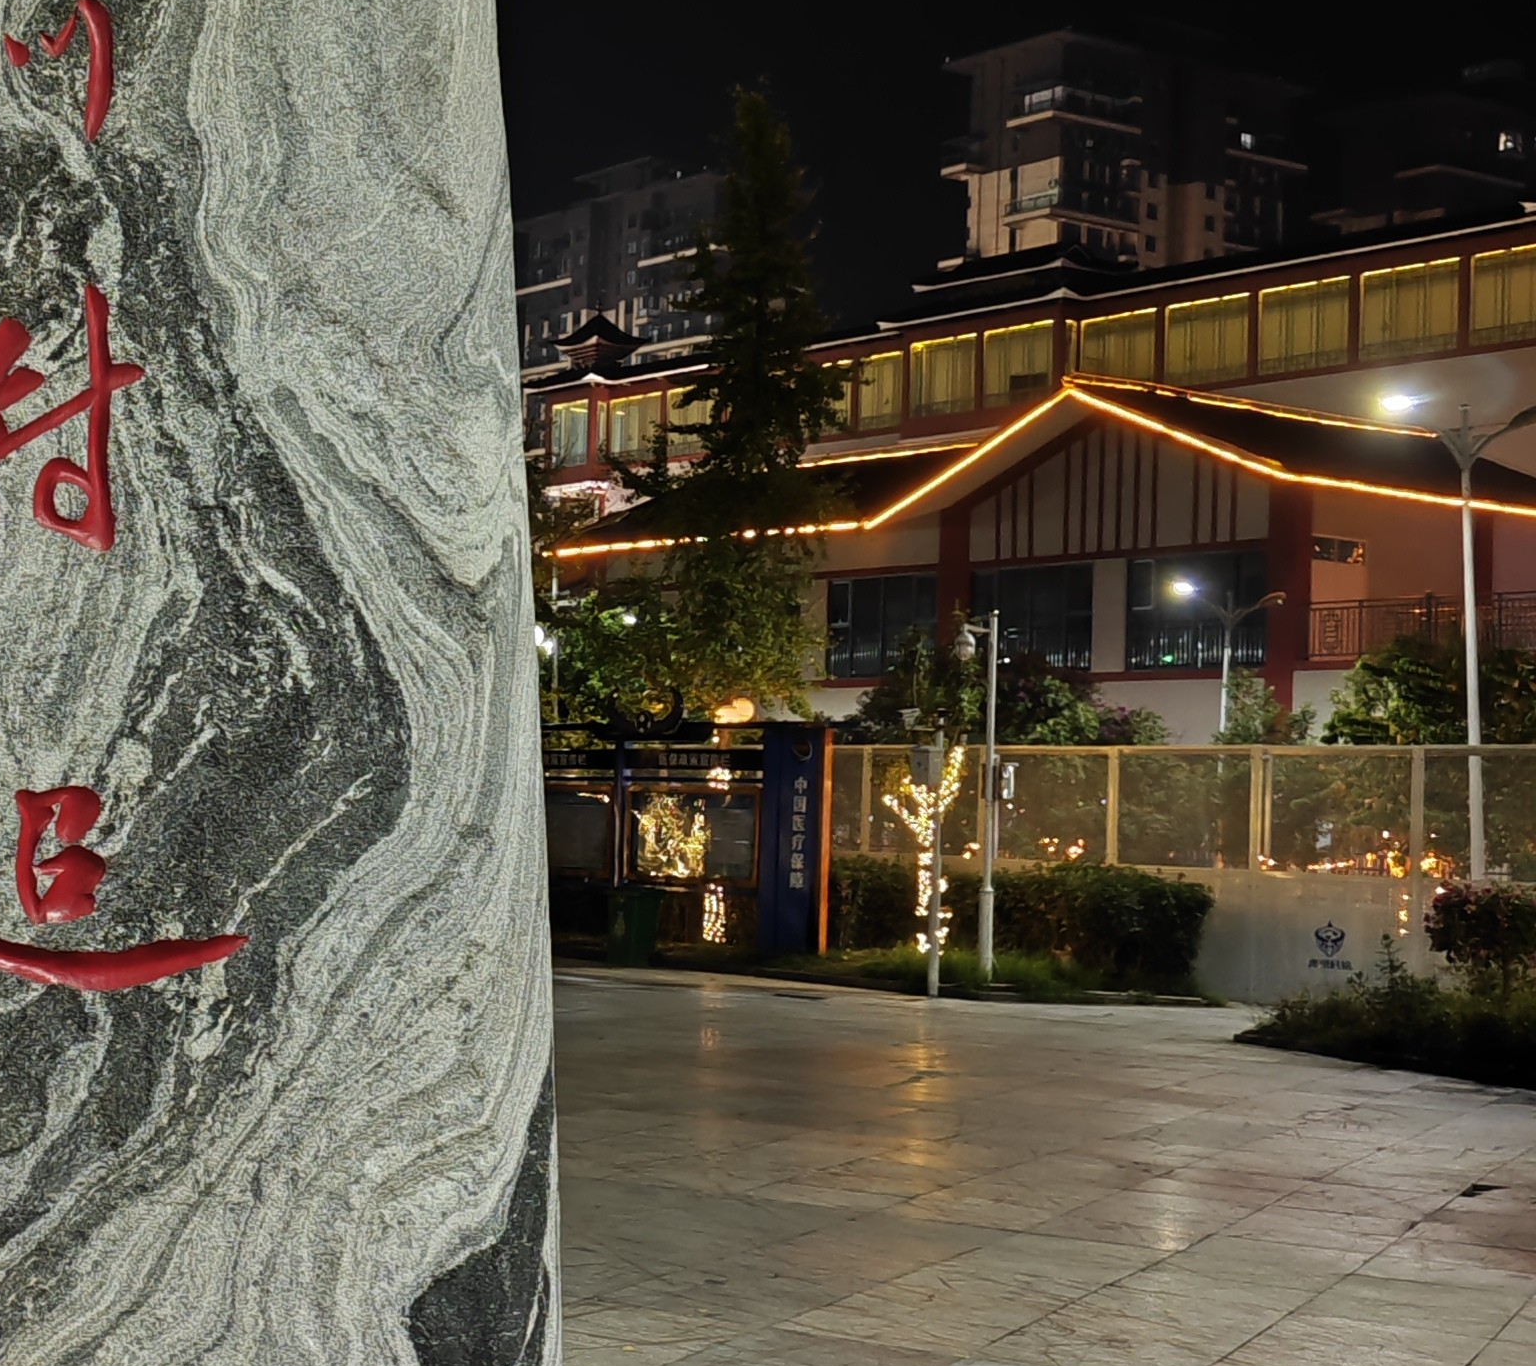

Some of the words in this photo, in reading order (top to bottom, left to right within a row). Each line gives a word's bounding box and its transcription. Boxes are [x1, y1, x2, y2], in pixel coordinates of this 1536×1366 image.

[789, 776, 808, 889] 中国医疗保障
